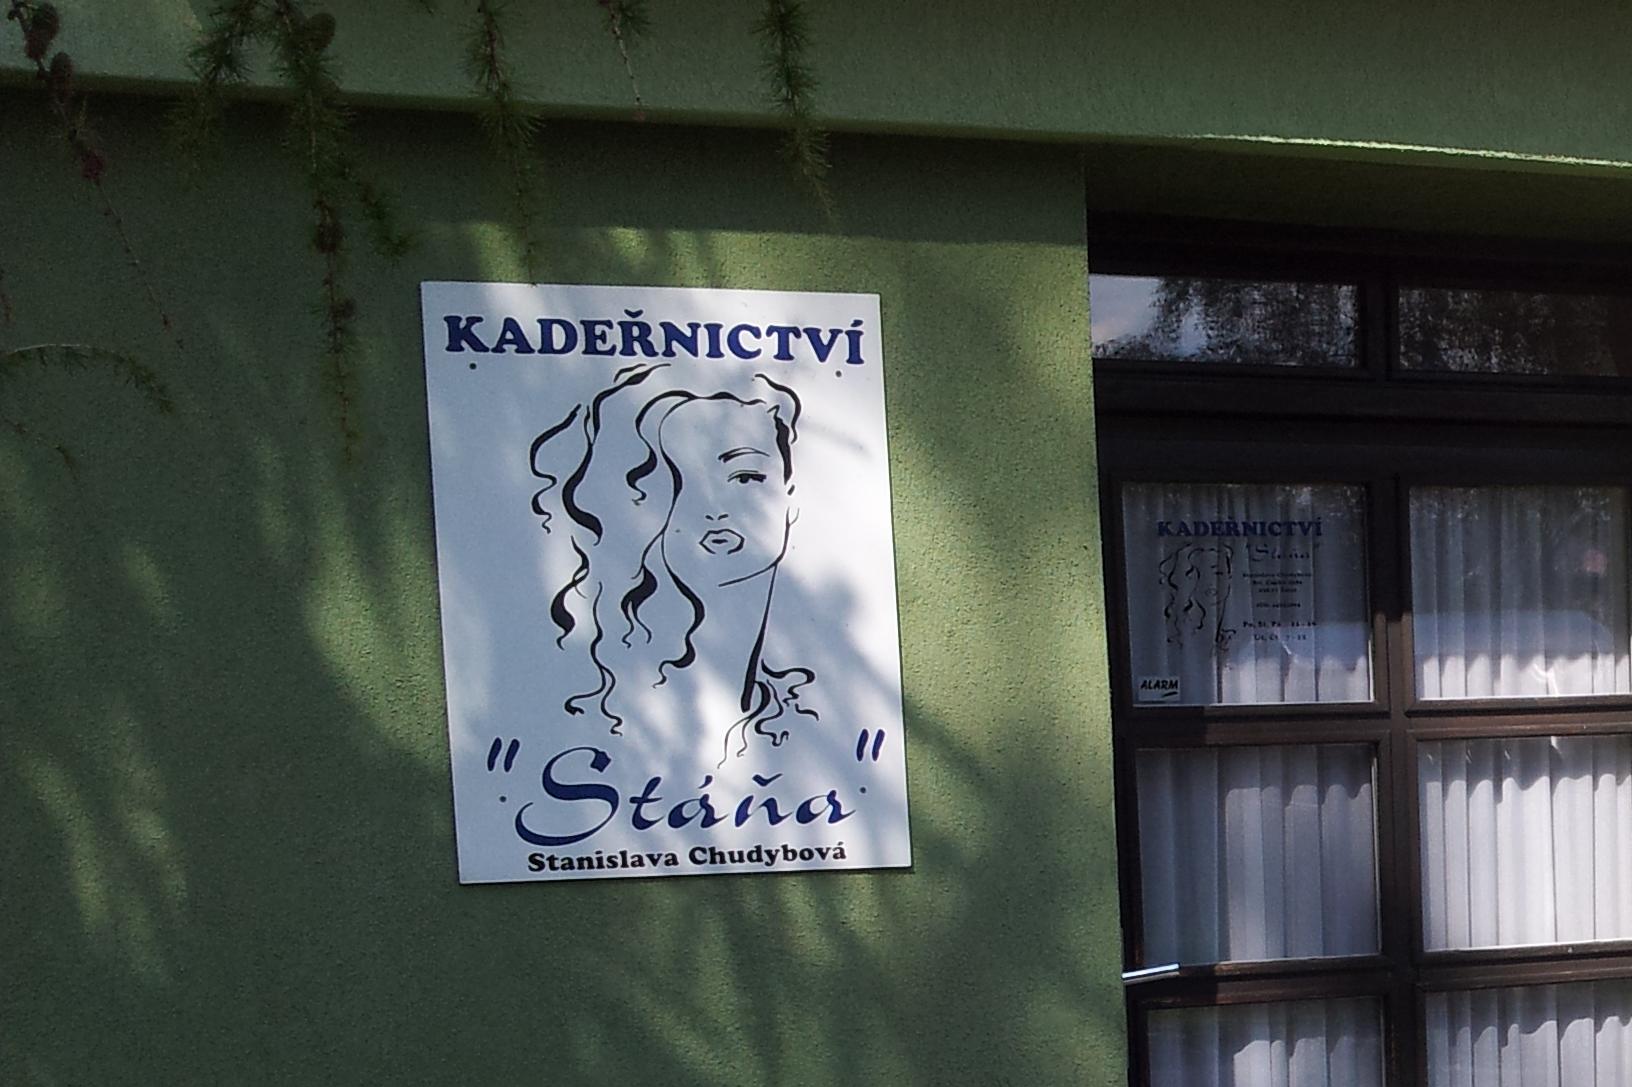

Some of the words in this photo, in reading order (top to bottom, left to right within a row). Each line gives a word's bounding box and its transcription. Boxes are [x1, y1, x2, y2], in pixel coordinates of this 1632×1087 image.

[443, 309, 866, 366] KADEŘNICTVÍ
[1157, 516, 1322, 537] KADEŘNICTVÍ
[1140, 679, 1179, 691] ALARM
[527, 849, 679, 873] Stanislava
[688, 840, 847, 869] Chudybová
